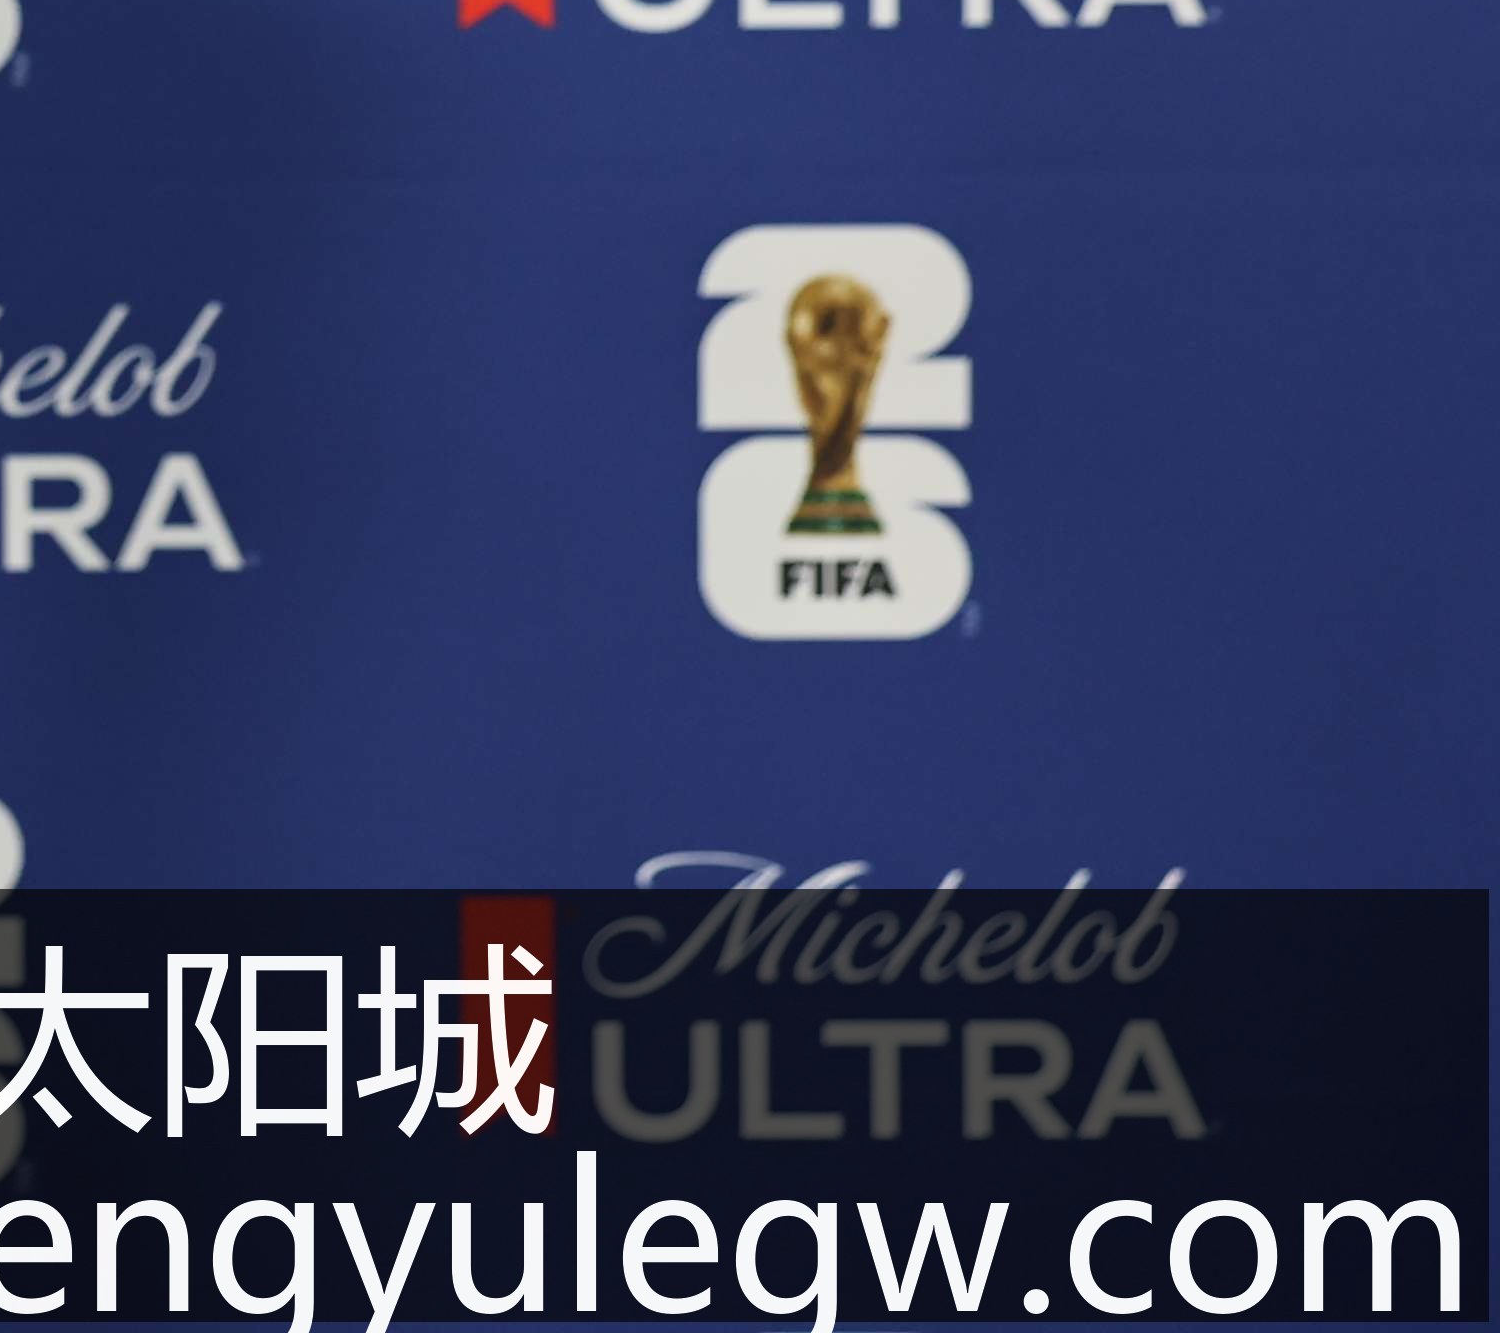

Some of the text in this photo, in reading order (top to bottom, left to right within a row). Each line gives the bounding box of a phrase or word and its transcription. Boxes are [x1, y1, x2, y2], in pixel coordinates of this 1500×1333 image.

[778, 558, 897, 600] FIFA
[580, 850, 1188, 999] Michelob
[590, 1017, 1209, 1142] ULTRA
